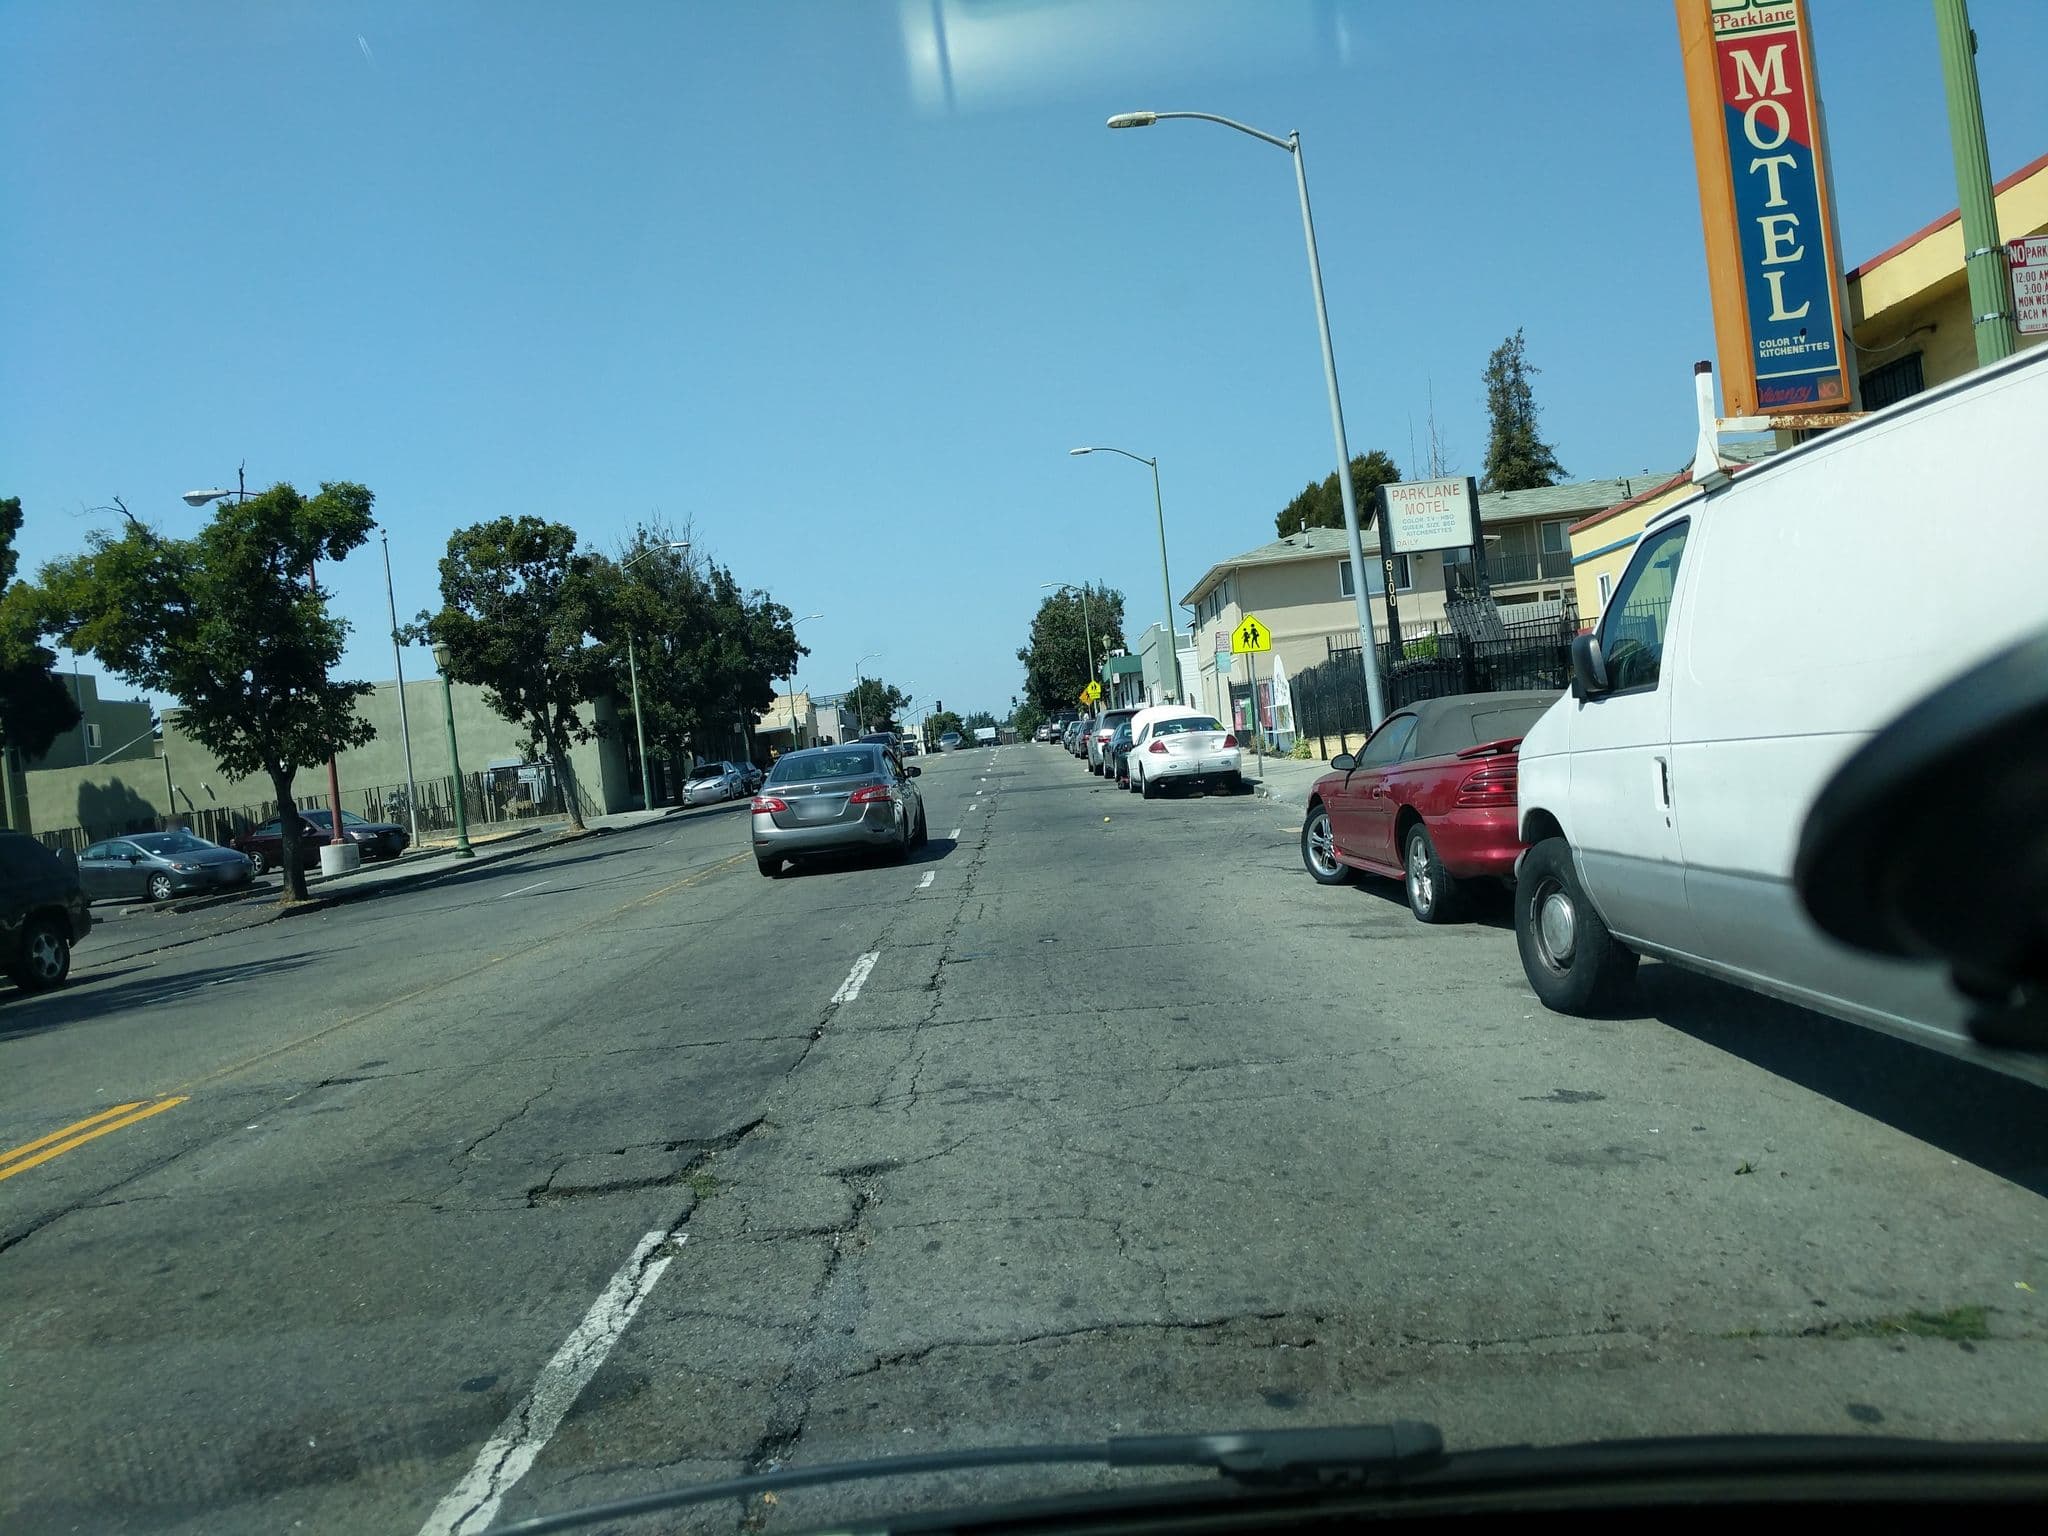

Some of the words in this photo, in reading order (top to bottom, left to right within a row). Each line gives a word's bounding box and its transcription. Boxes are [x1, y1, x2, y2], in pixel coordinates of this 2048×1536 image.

[1712, 9, 1795, 30] Parklane
[1729, 43, 1810, 322] MOTEL
[2010, 244, 2026, 264] NO
[2018, 296, 2034, 308] MON
[2018, 309, 2039, 320] EACH
[1759, 337, 1790, 349] COLOR
[1792, 335, 1805, 345] TV
[1760, 341, 1830, 358] KITCHENETTES
[1392, 484, 1461, 501] PARKLANE
[1405, 500, 1450, 516] MOTEL
[1402, 517, 1424, 525] COLOR
[1385, 559, 1397, 607] 8100
